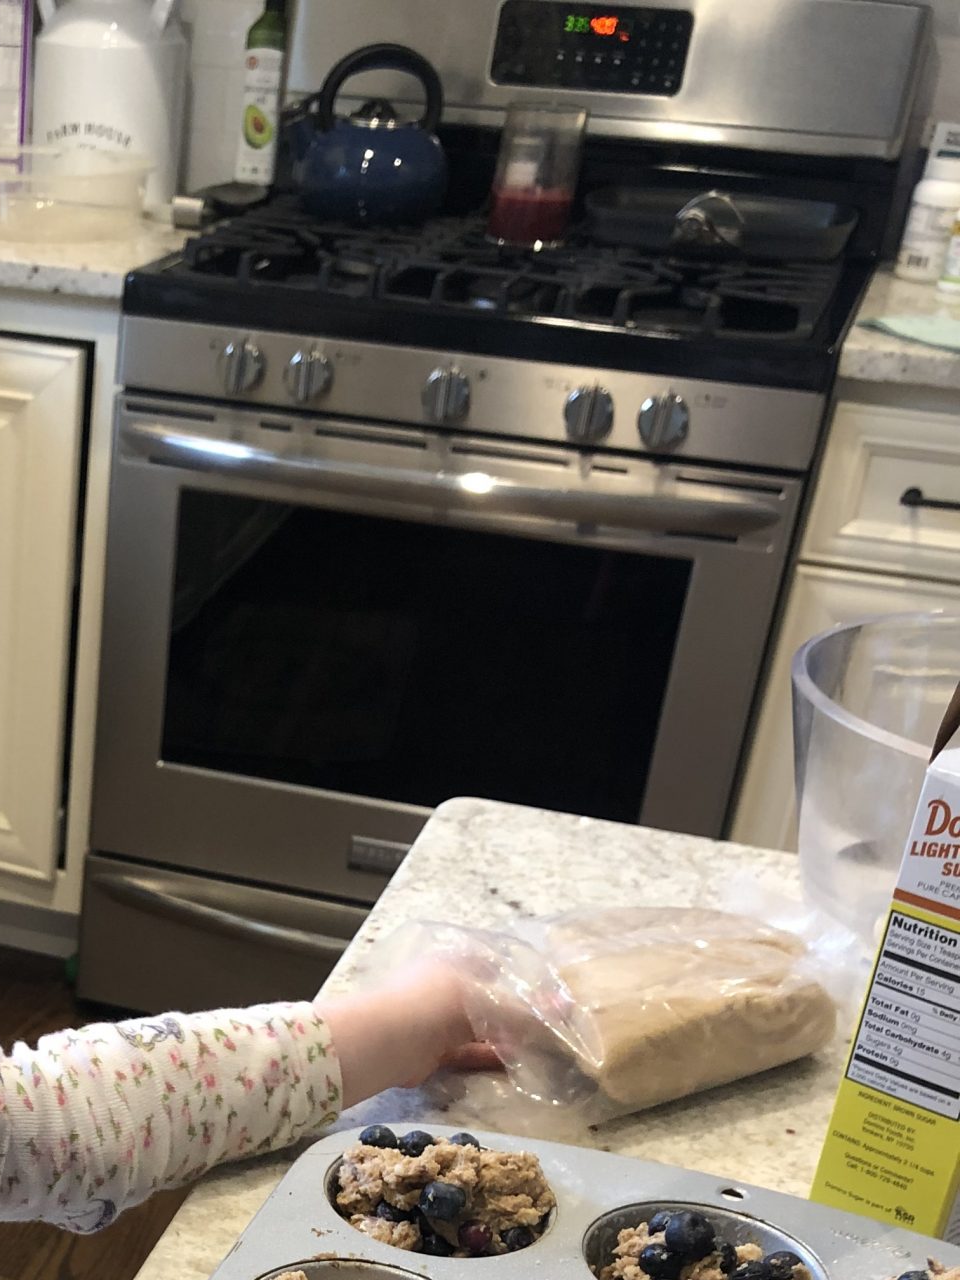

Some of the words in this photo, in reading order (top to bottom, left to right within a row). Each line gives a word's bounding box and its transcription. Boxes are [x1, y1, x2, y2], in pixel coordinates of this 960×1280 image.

[910, 841, 960, 859] LIGHT
[917, 881, 940, 895] PURE
[889, 929, 915, 946] Serving
[916, 940, 931, 950] Size
[892, 916, 958, 947] Nutrition
[887, 938, 915, 955] Servings
[916, 950, 928, 959] Per
[877, 972, 913, 992] Calories
[916, 988, 925, 997] 15
[881, 961, 909, 975] Amount
[910, 971, 923, 980] Per
[925, 976, 955, 994] Serving
[871, 996, 892, 1010] Total
[895, 1006, 909, 1017] Fat
[911, 1012, 920, 1022] 0g
[940, 1010, 958, 1021] Daily
[868, 1009, 899, 1026] Sodium
[901, 1022, 918, 1035] 0mg
[864, 1020, 883, 1033] Total
[885, 1029, 939, 1055] Carbohydrate
[941, 1050, 952, 1061] 4g
[866, 1034, 891, 1050] Sugars
[893, 1045, 903, 1056] 4g
[857, 1044, 888, 1062] Protein
[890, 1057, 899, 1067] 0g
[868, 1111, 906, 1131] DISTRIBUTED
[893, 1104, 915, 1118] BROWN
[916, 1113, 936, 1126] SUGAR
